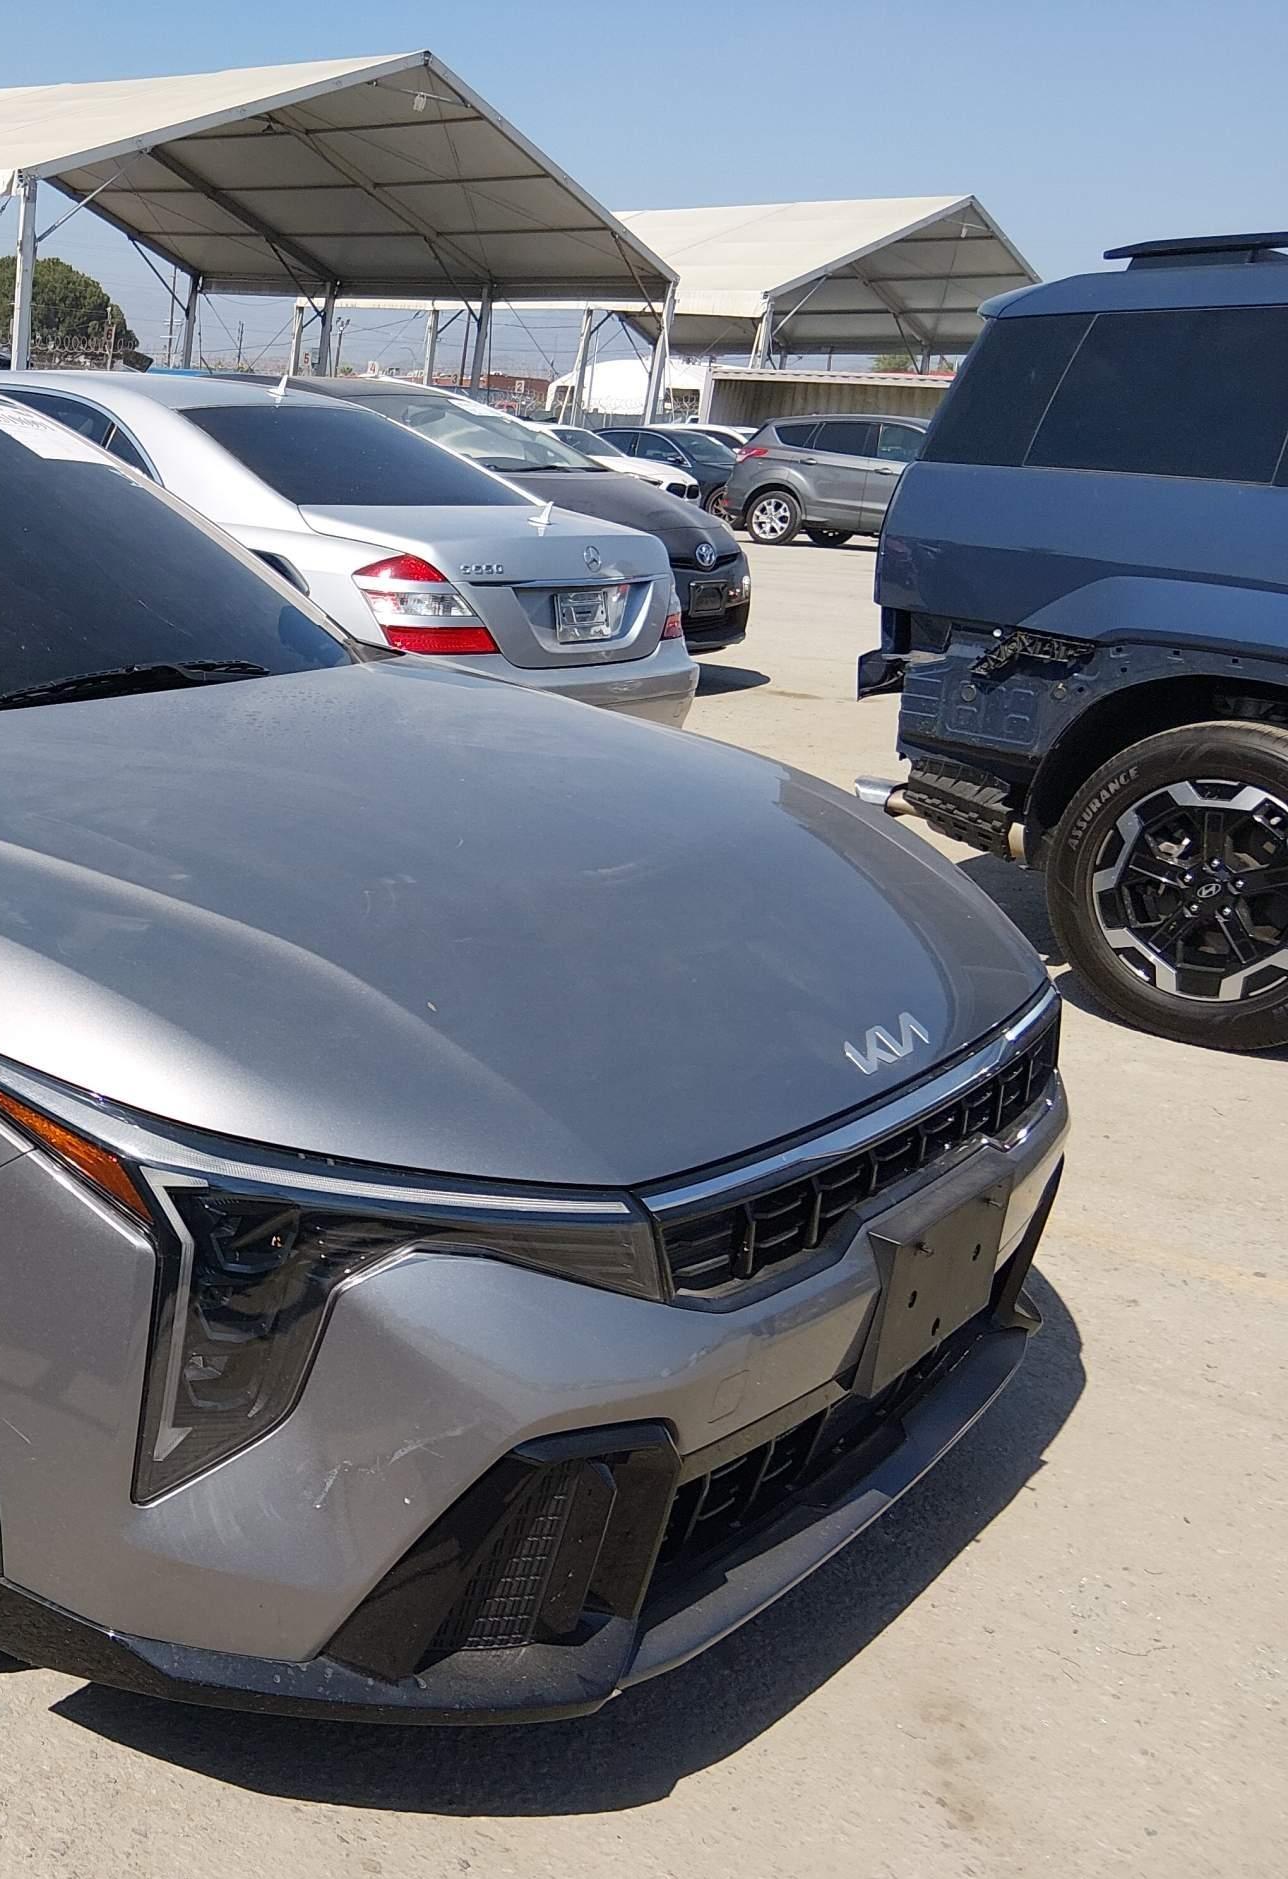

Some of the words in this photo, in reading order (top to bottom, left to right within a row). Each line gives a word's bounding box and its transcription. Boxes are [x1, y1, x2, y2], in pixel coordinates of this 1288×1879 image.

[107, 328, 113, 340] 6
[304, 352, 310, 364] 5
[516, 382, 523, 392] 2
[1068, 766, 1140, 850] ASSURANCE
[844, 1012, 930, 1075] KIA
